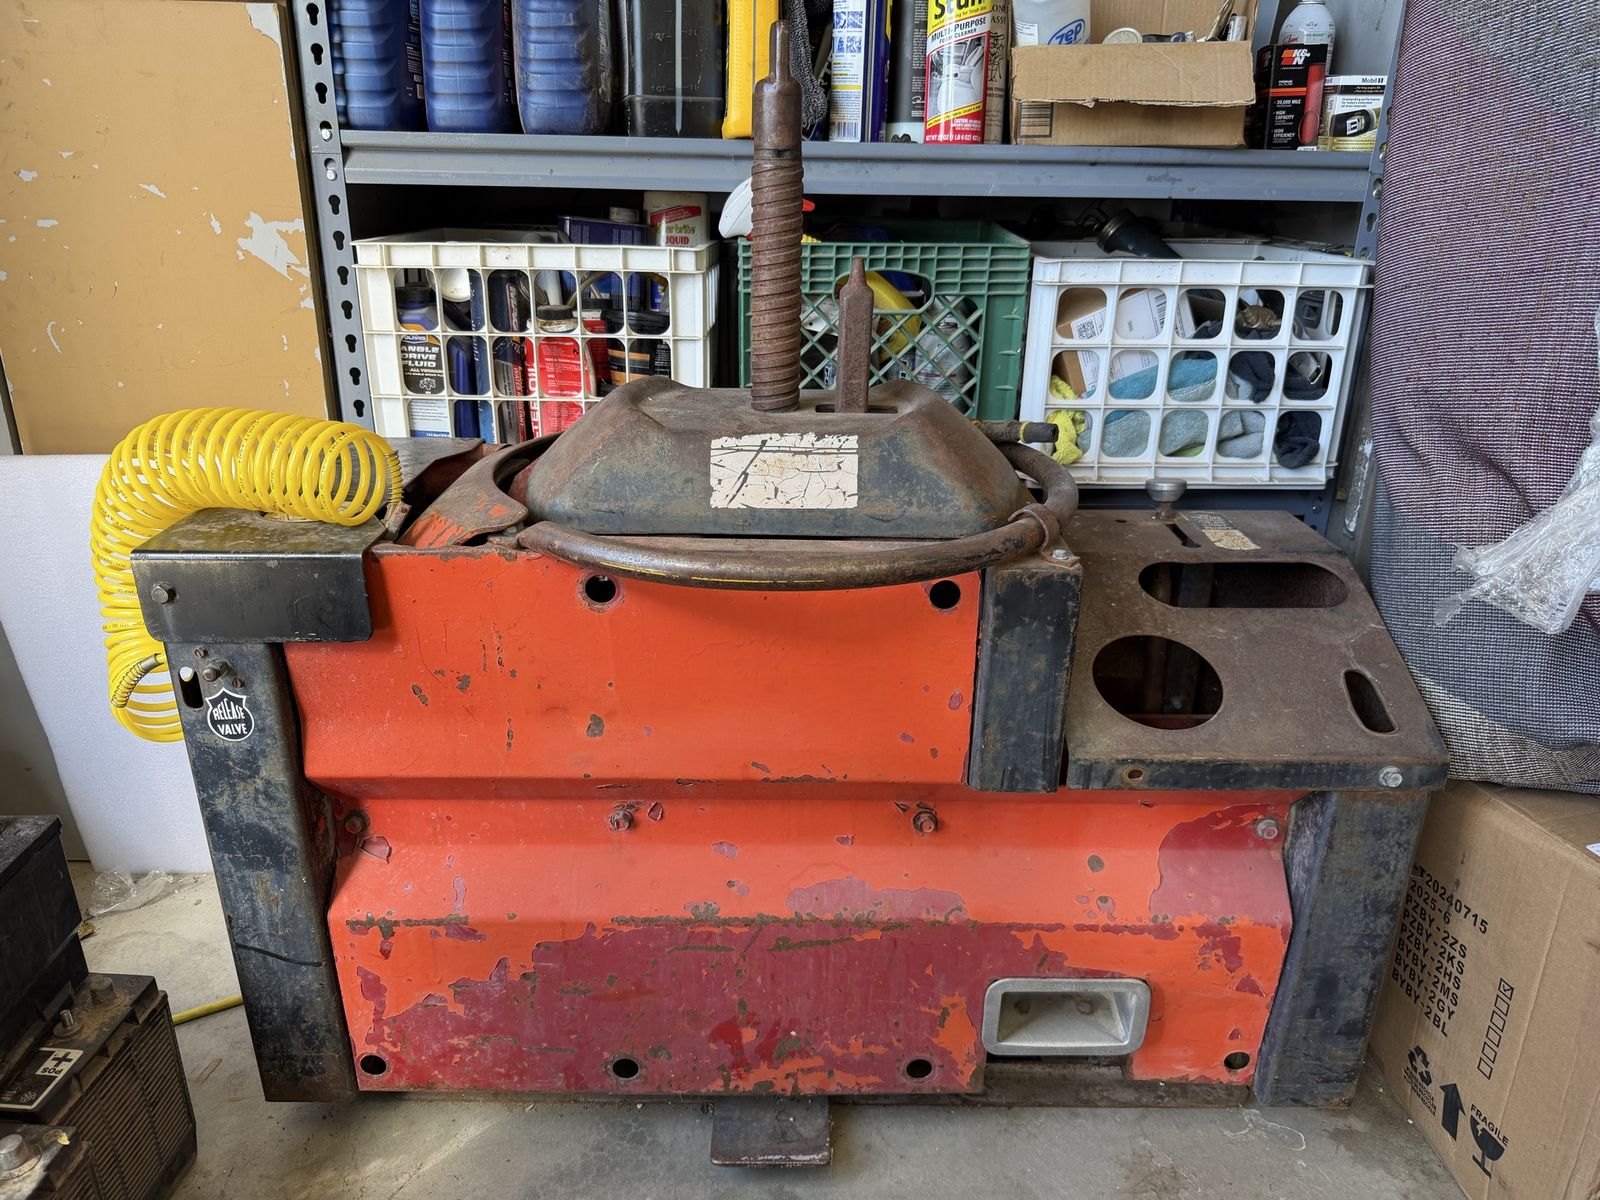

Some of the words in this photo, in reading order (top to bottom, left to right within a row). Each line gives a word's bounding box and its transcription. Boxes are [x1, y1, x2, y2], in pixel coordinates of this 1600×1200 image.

[931, 17, 986, 42] MULTI-PURPOSE
[954, 28, 977, 39] CLEANER
[666, 236, 689, 245] IQUID
[401, 345, 439, 353] ANGLE
[403, 360, 437, 368] FLUID
[212, 698, 246, 721] RELEASE
[217, 722, 248, 736] VALVE
[1410, 879, 1451, 925] 2025-6
[1403, 908, 1464, 976] PZBY-2KS
[1406, 893, 1467, 959] PZBY-2ZS
[1398, 938, 1458, 1007] BYBY-2MS
[1401, 922, 1461, 991] PZBY-2HS
[1392, 967, 1448, 1038] BYBY-2BL
[1395, 952, 1455, 1021] BYBY-2GY
[41, 1067, 64, 1075] POS
[1470, 1103, 1509, 1147] FRAGILE
